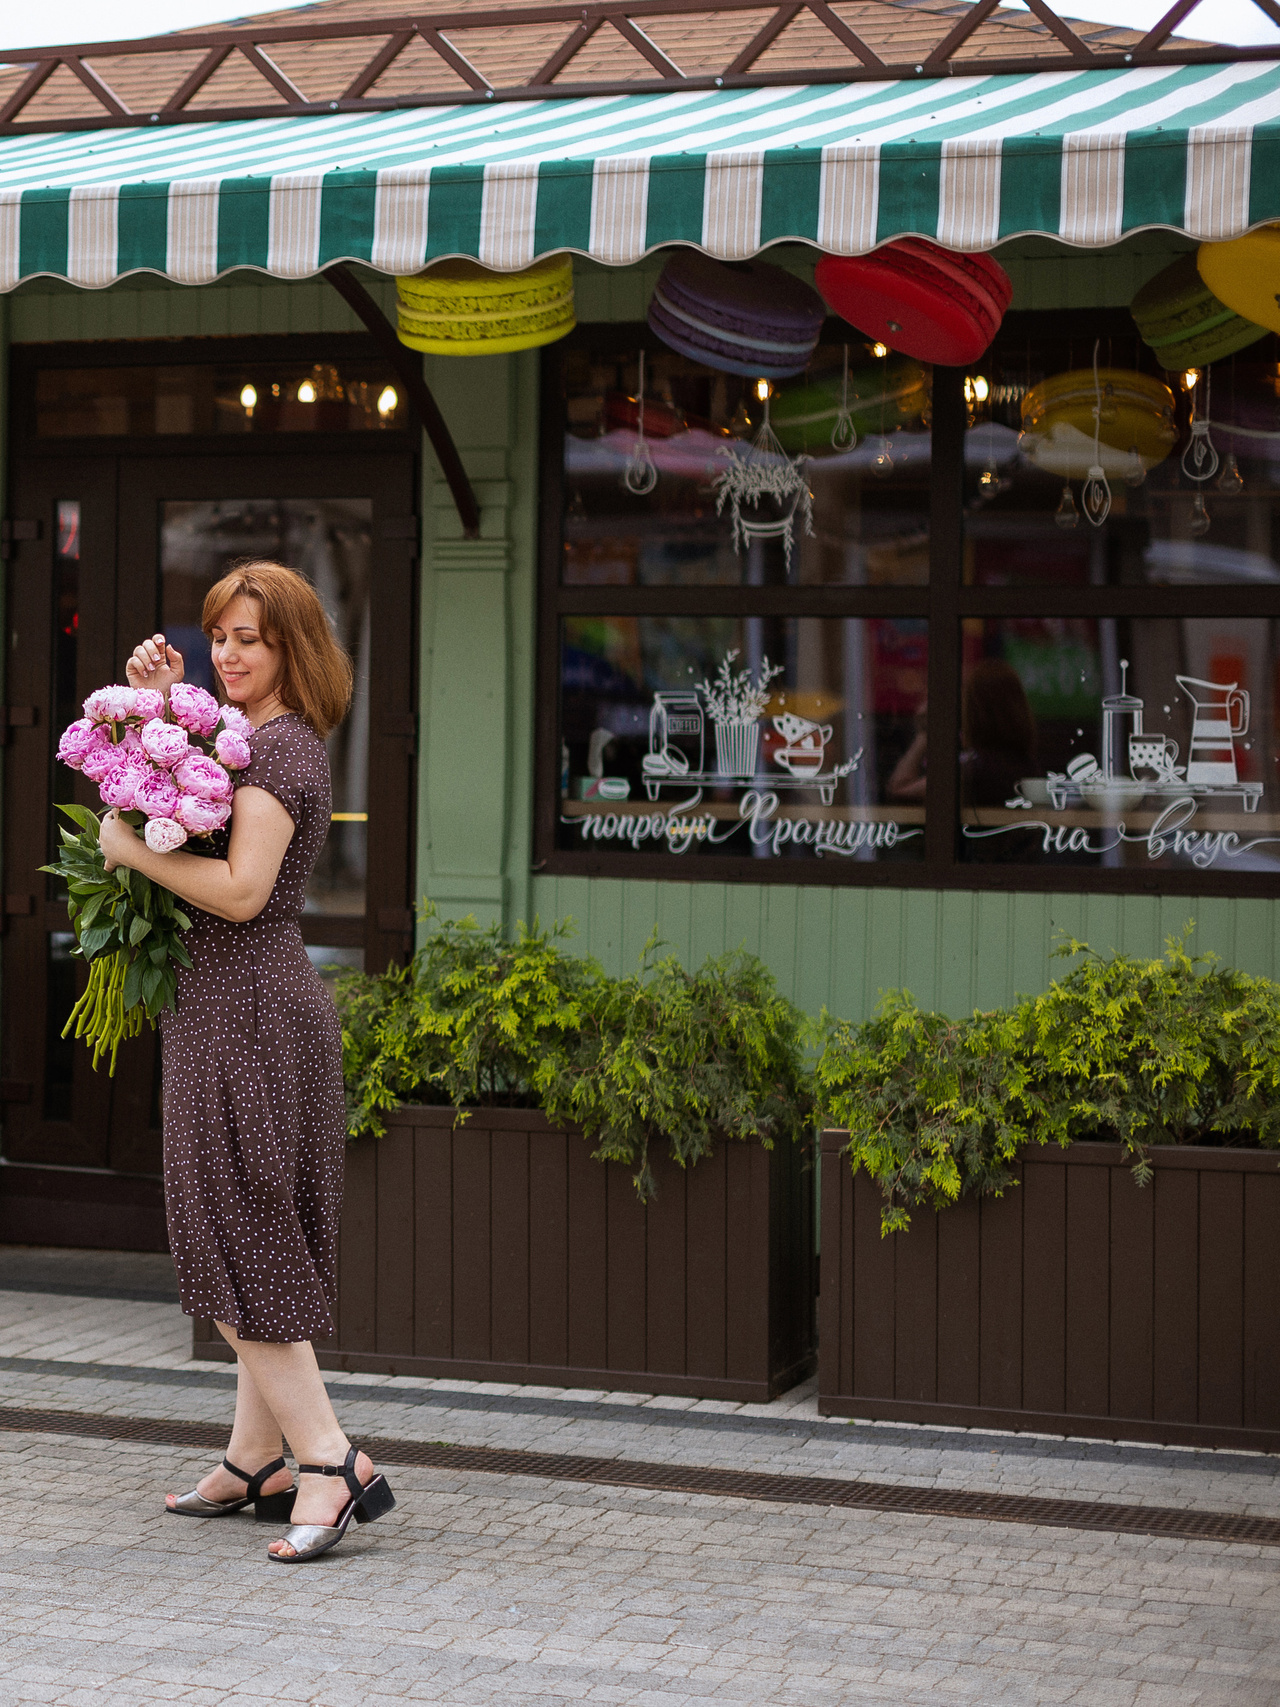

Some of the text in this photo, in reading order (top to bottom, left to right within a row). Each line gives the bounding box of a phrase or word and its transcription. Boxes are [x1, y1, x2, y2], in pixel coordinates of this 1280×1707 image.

[671, 719, 698, 732] COFFEE
[575, 787, 902, 857] попробуй Францию
[1145, 796, 1252, 868] вкус
